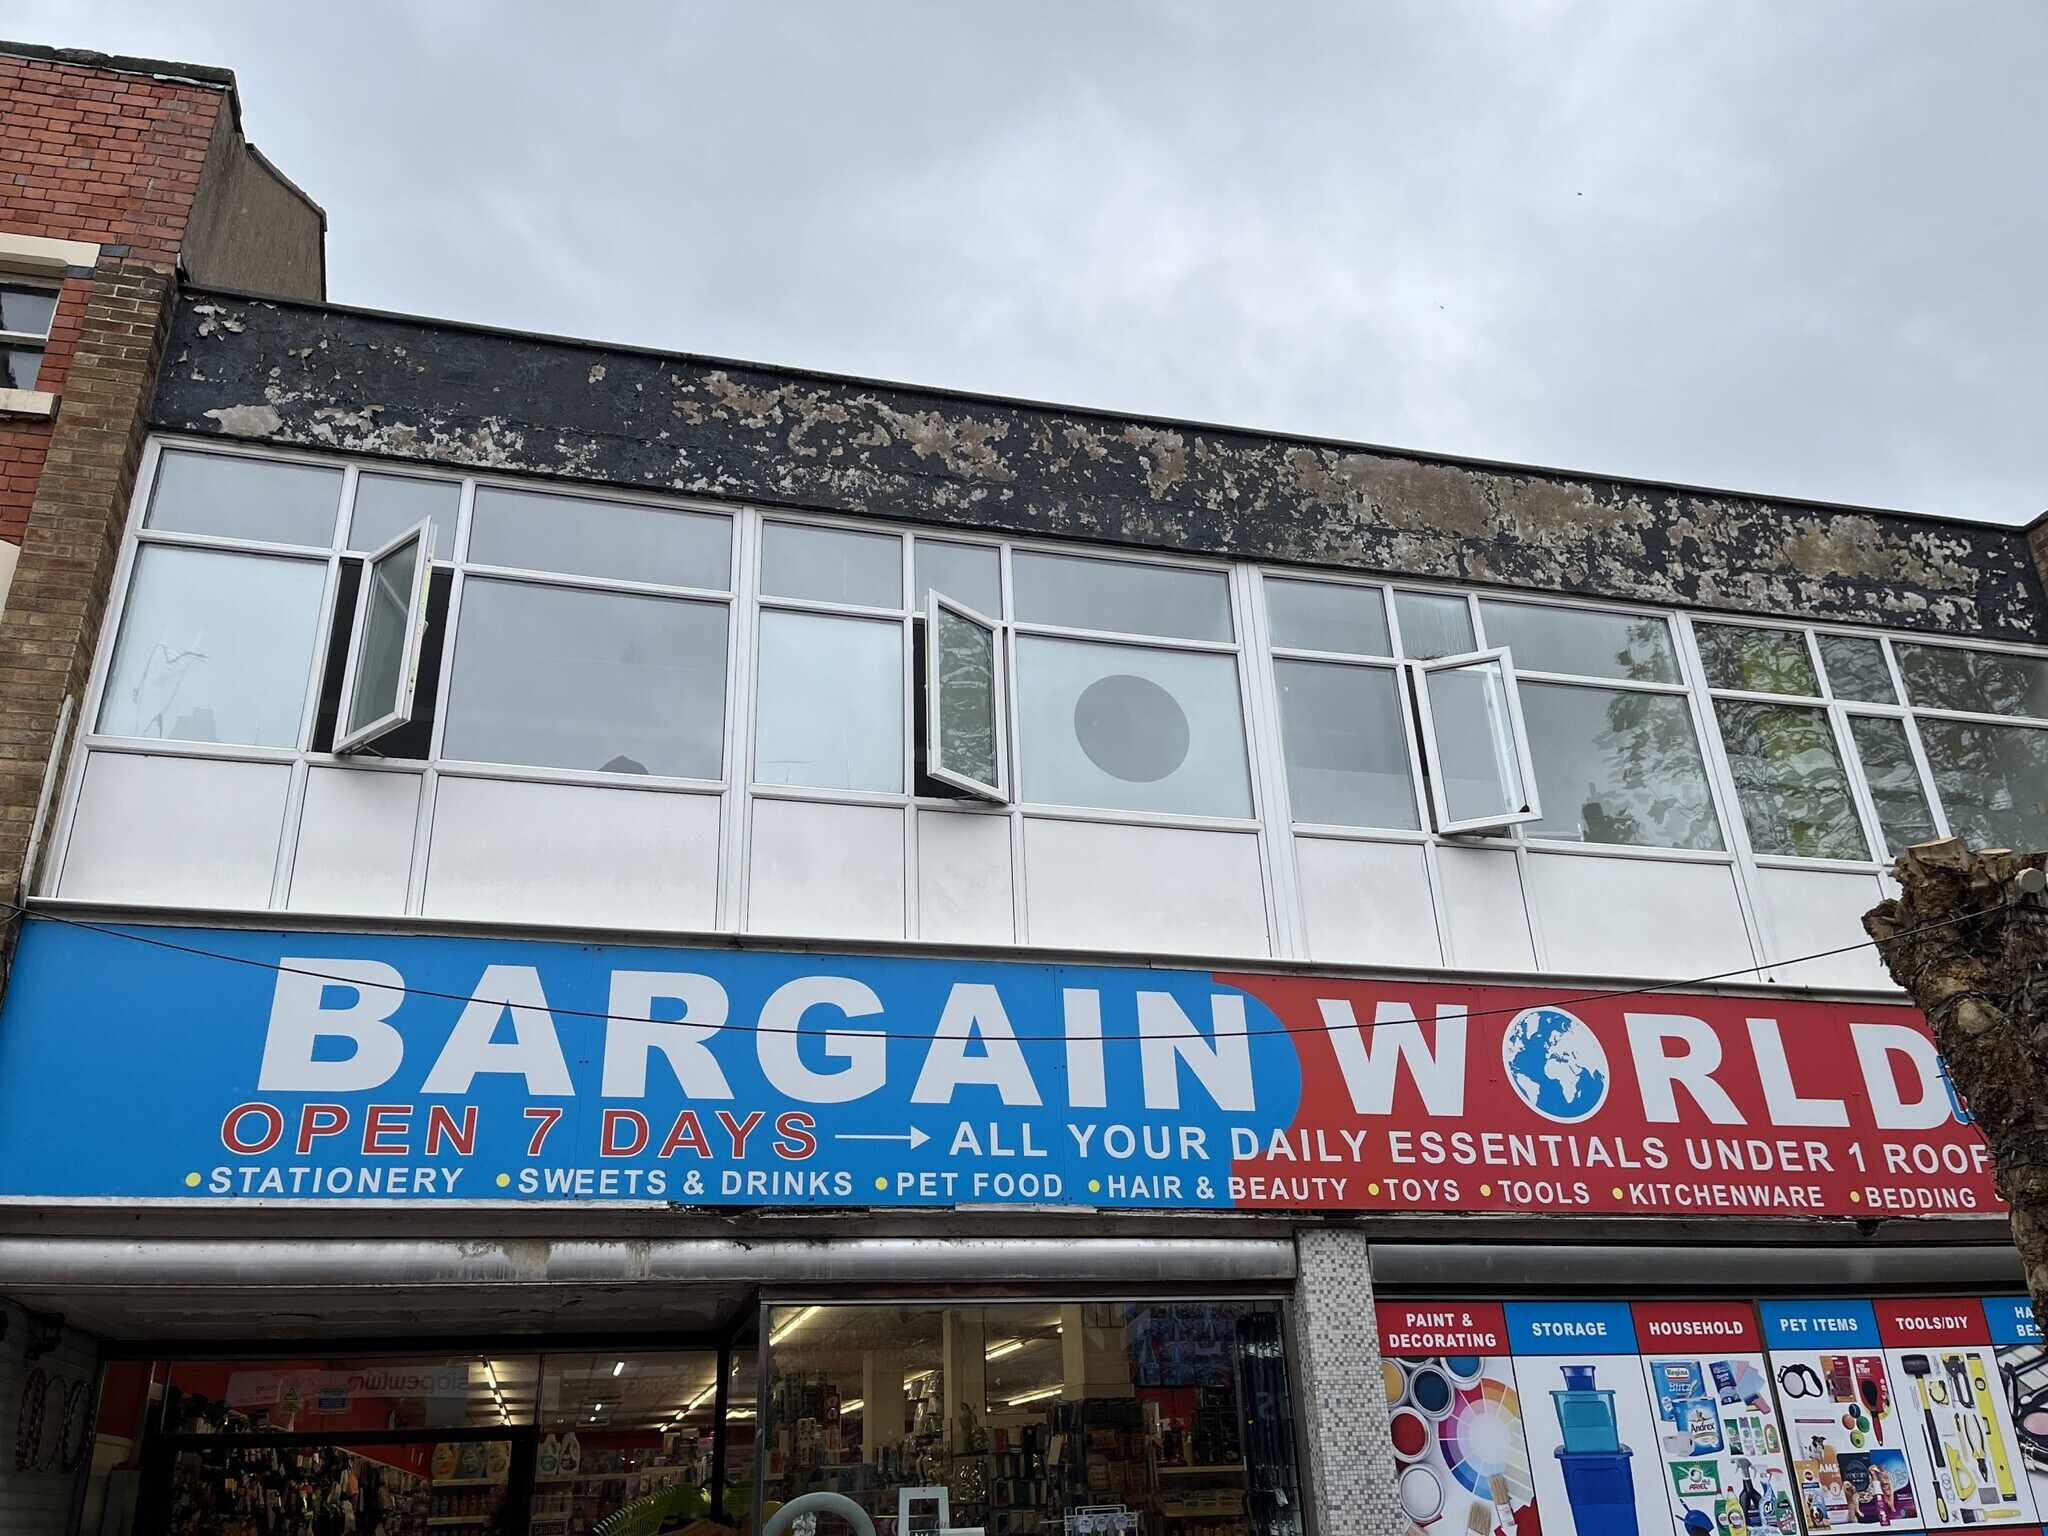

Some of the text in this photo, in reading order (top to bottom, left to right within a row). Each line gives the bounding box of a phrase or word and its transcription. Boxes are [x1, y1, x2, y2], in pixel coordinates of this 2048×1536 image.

[257, 957, 1256, 1112] BARGAIN
[221, 1102, 819, 1161] OPEN 7 DAYS
[950, 1122, 1988, 1173] ALL YOUR DAILY ESSENTIALS UNDER 1 ROOF
[210, 1167, 462, 1192] STATIONERY
[519, 1169, 851, 1195] SWEETS & DRINKS
[898, 1173, 1061, 1196] PET FOOD
[1109, 1176, 1346, 1199] HAIR & BEAUTY
[1384, 1179, 1459, 1201] TOYS
[1498, 1181, 1589, 1203] TOOLS
[1629, 1184, 1824, 1206] KITCHENWARE
[1865, 1187, 1976, 1208] BEDDING
[1407, 1314, 1473, 1326] PAINT &
[1896, 1317, 1967, 1329] TOOLS/DIY
[2015, 1307, 2034, 1318] HA
[1533, 1323, 1606, 1335] STORAGE
[1649, 1322, 1742, 1335] HOUSEHOLD
[1781, 1319, 1857, 1330] PET ITEMS
[1389, 1334, 1496, 1347] DECORATING
[1666, 1368, 1688, 1377] Regina
[1690, 1422, 1715, 1433] Andrex
[1689, 1483, 1708, 1491] ARIEL
